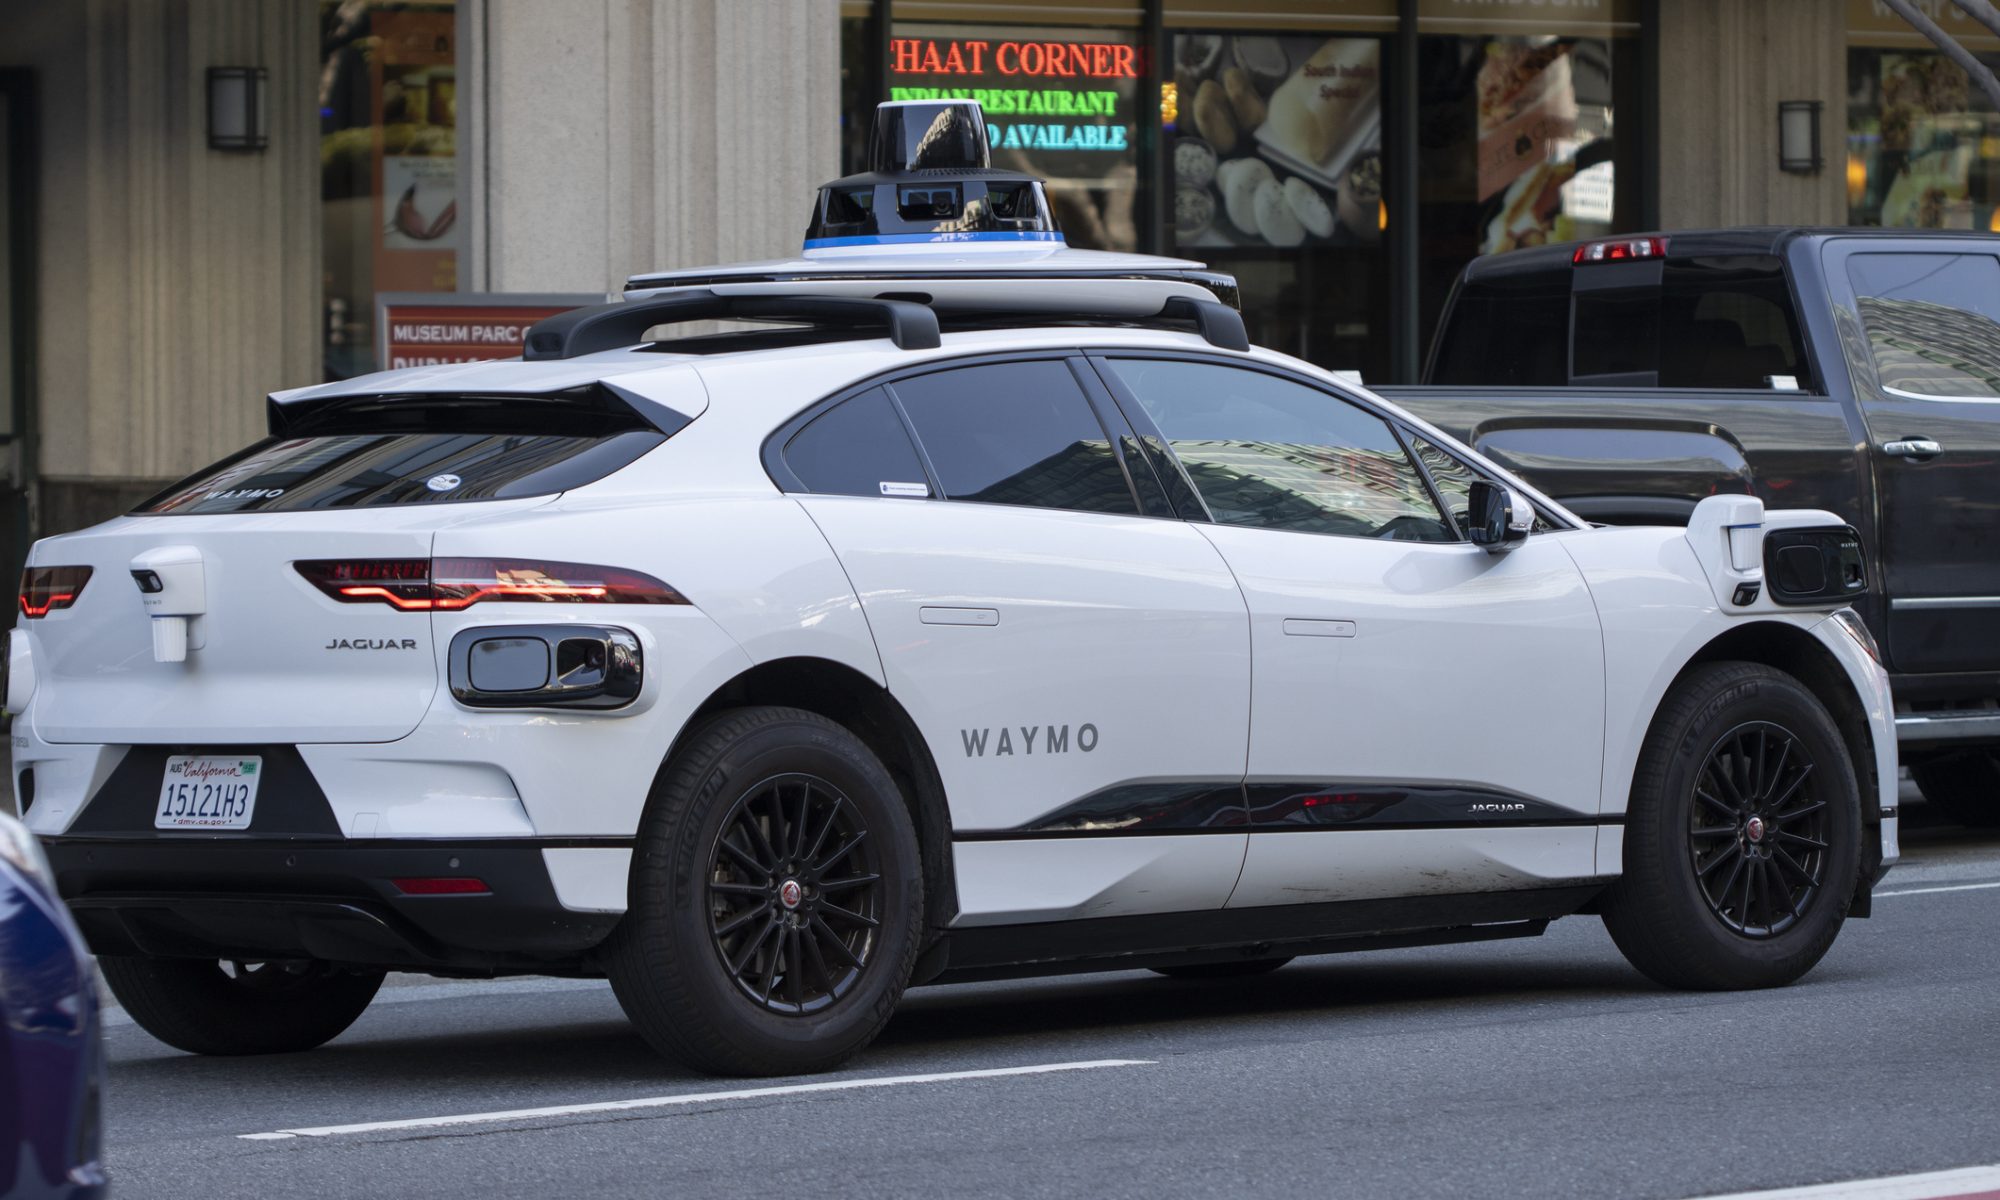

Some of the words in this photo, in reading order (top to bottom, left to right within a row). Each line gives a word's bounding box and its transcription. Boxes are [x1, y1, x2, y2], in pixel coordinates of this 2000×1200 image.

[995, 43, 1138, 77] CORNER
[974, 90, 1118, 115] RESTAURANT
[1002, 124, 1128, 149] AVAILABLE
[393, 325, 468, 341] MUSEUM
[471, 326, 518, 342] PARC
[203, 488, 284, 500] WAYMO
[325, 638, 418, 650] JAGUAR
[960, 722, 1099, 758] WAYMO
[183, 760, 242, 782] California
[162, 783, 249, 817] 15121H3
[1467, 803, 1526, 813] JAGUAR
[177, 818, 227, 826] dmv.ca.gov
